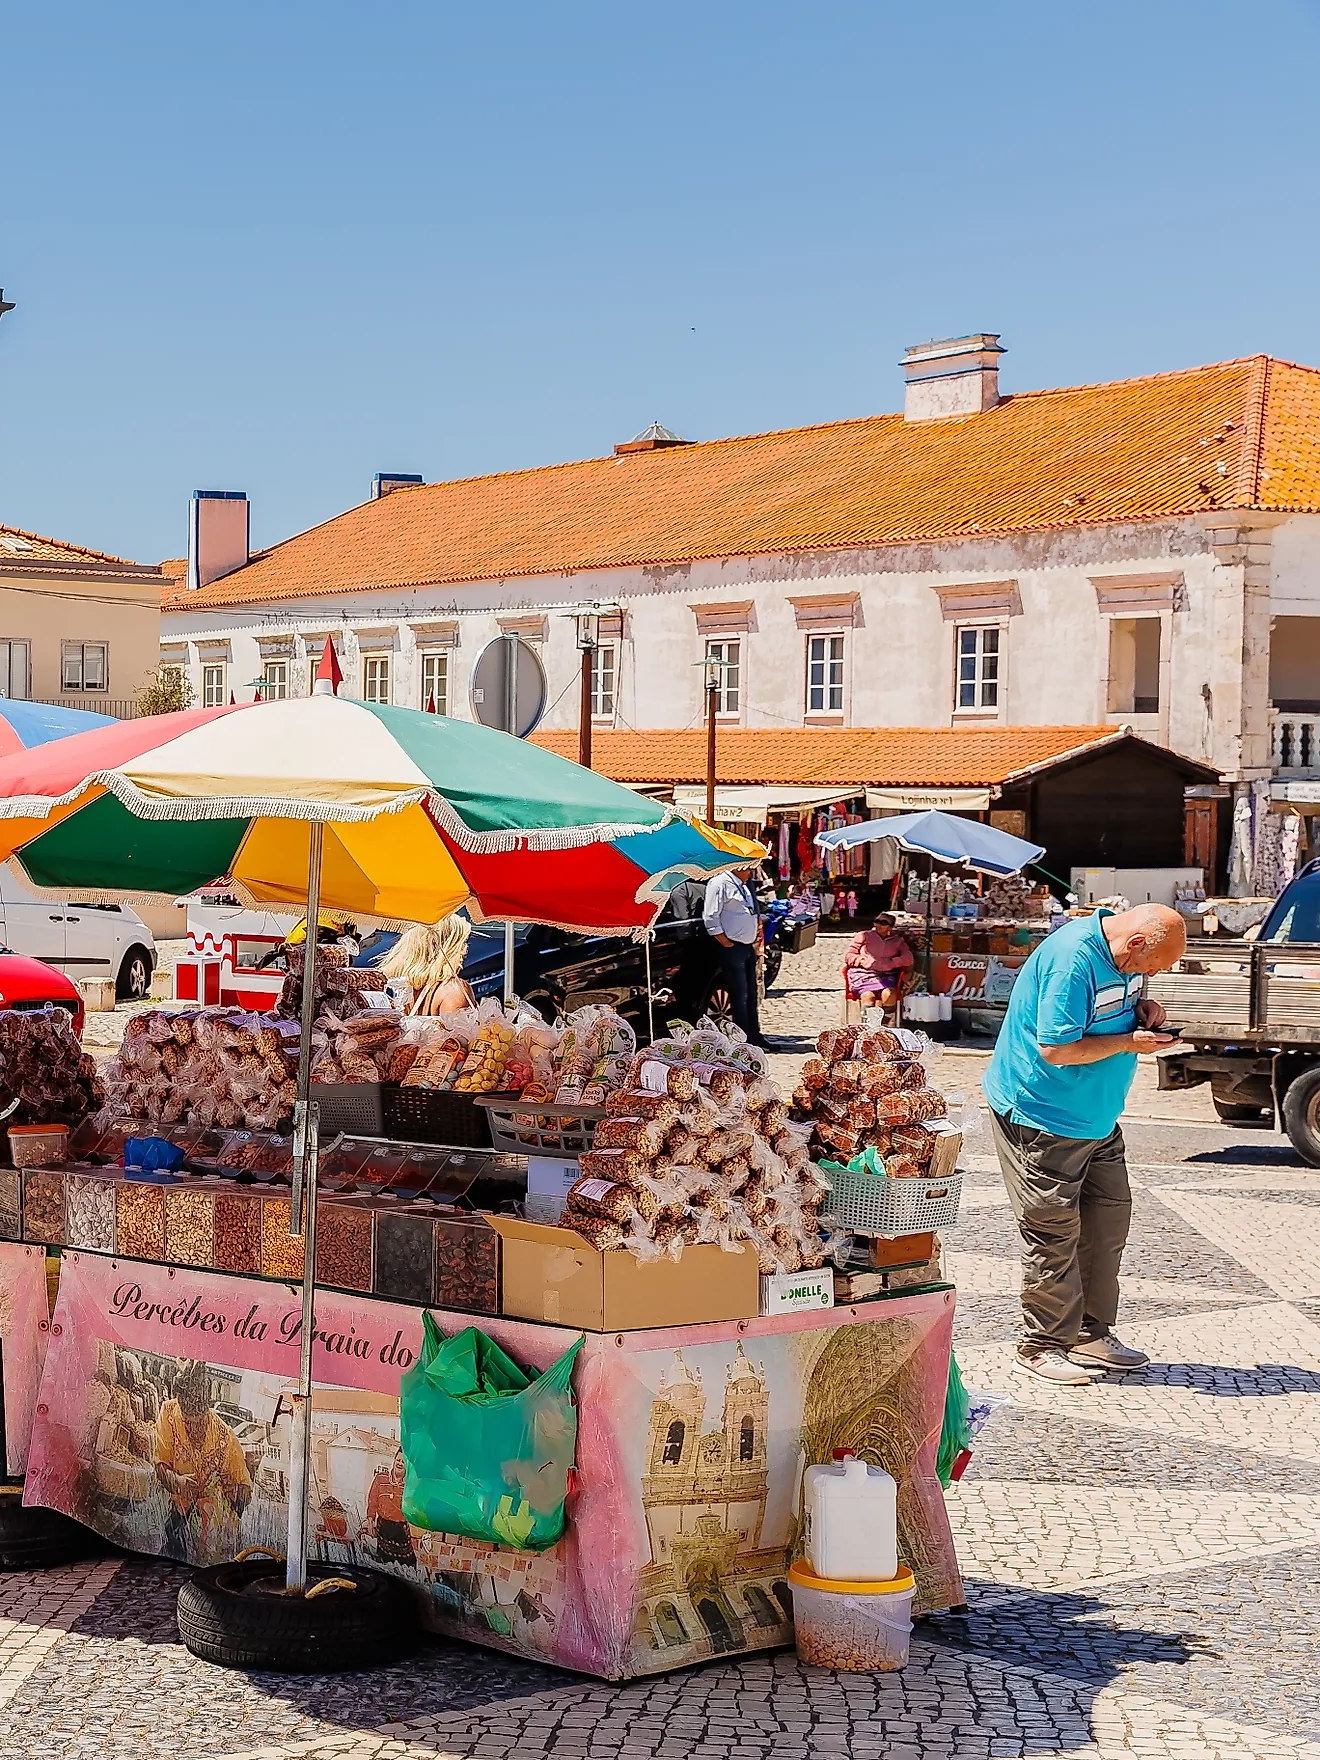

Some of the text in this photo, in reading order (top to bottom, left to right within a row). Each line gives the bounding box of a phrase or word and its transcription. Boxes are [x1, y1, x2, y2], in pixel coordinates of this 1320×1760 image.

[945, 973, 986, 1001] Lui
[780, 1284, 822, 1301] ONELLE
[108, 1281, 418, 1369] Percêbes da Praia do
